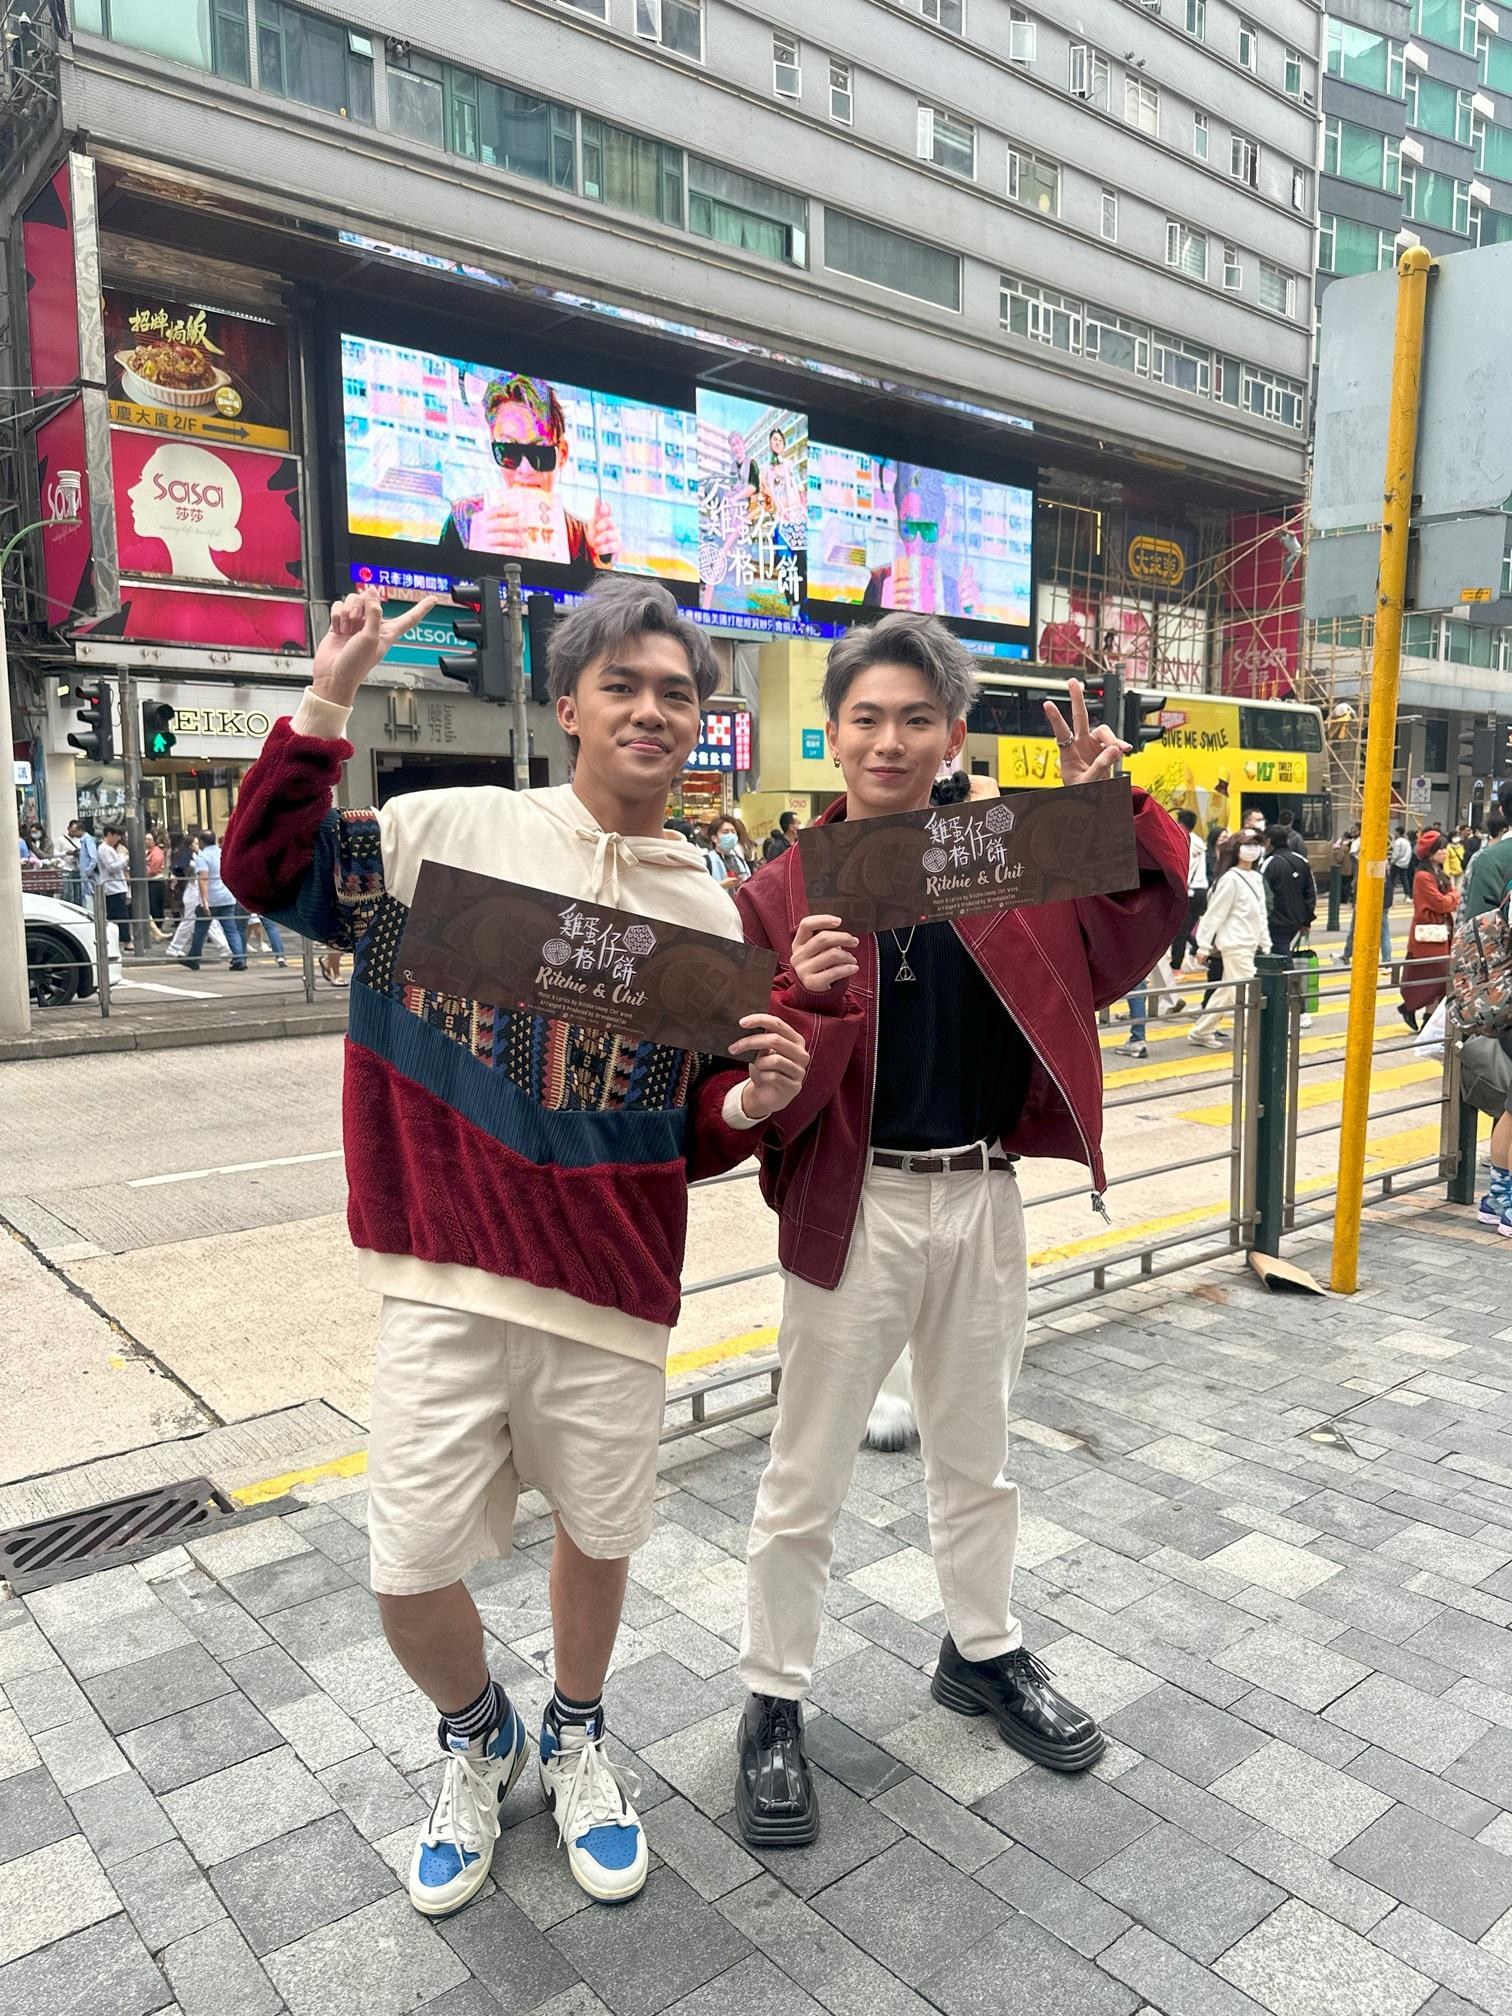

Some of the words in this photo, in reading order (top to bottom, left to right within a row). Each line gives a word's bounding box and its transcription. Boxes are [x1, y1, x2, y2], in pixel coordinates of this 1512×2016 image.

[173, 415, 198, 430] 2/F
[175, 506, 204, 523] 莎莎
[398, 626, 468, 646] atson
[1162, 729, 1182, 749] GIVE
[1184, 730, 1197, 749] ME
[1200, 728, 1229, 752] SMILE
[926, 873, 973, 897] Ritchie
[977, 870, 990, 885] &
[994, 861, 1026, 884] Chit
[535, 965, 589, 994] Ritchie
[592, 983, 606, 999] &
[612, 983, 649, 1007] Chit
